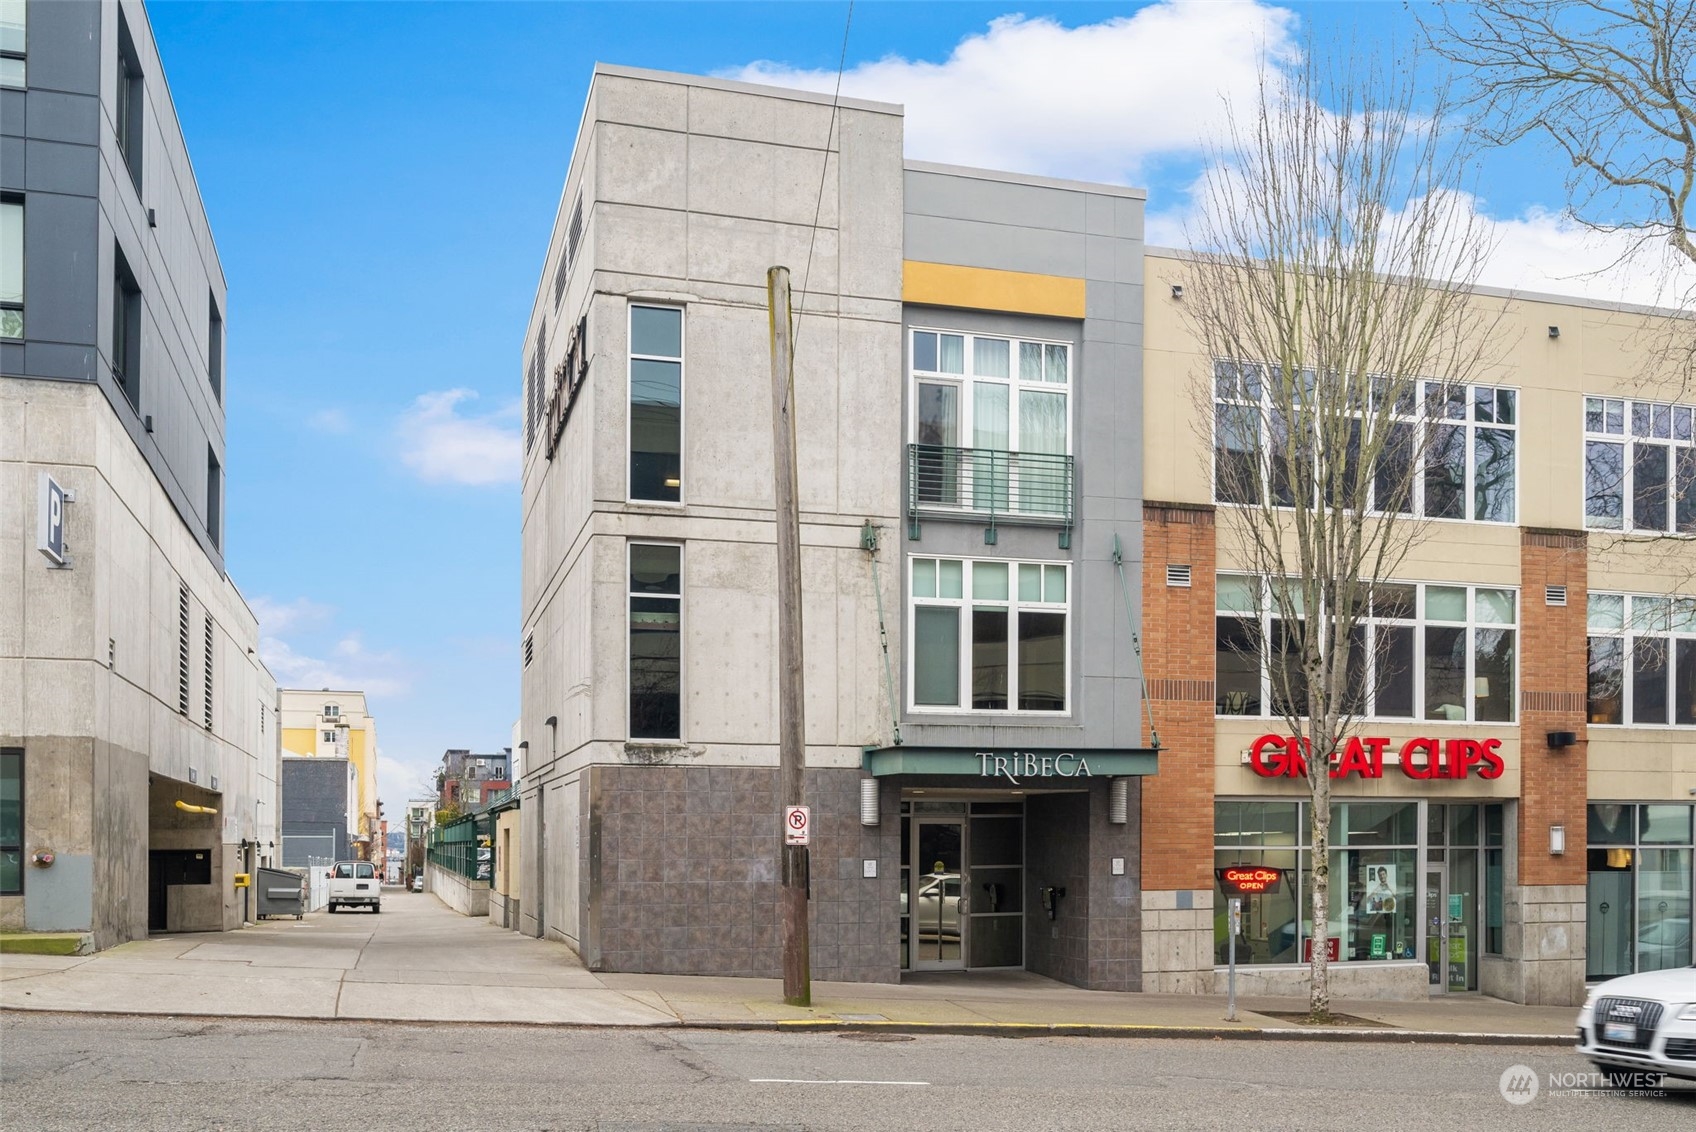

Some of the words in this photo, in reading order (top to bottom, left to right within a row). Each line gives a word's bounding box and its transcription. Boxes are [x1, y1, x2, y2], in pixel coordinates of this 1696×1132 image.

[50, 488, 61, 544] P
[1251, 734, 1391, 779] GRAT
[1401, 737, 1505, 779] CLIPS
[1227, 870, 1254, 881] Great
[1254, 870, 1277, 883] Clips
[1239, 882, 1264, 890] OPEN
